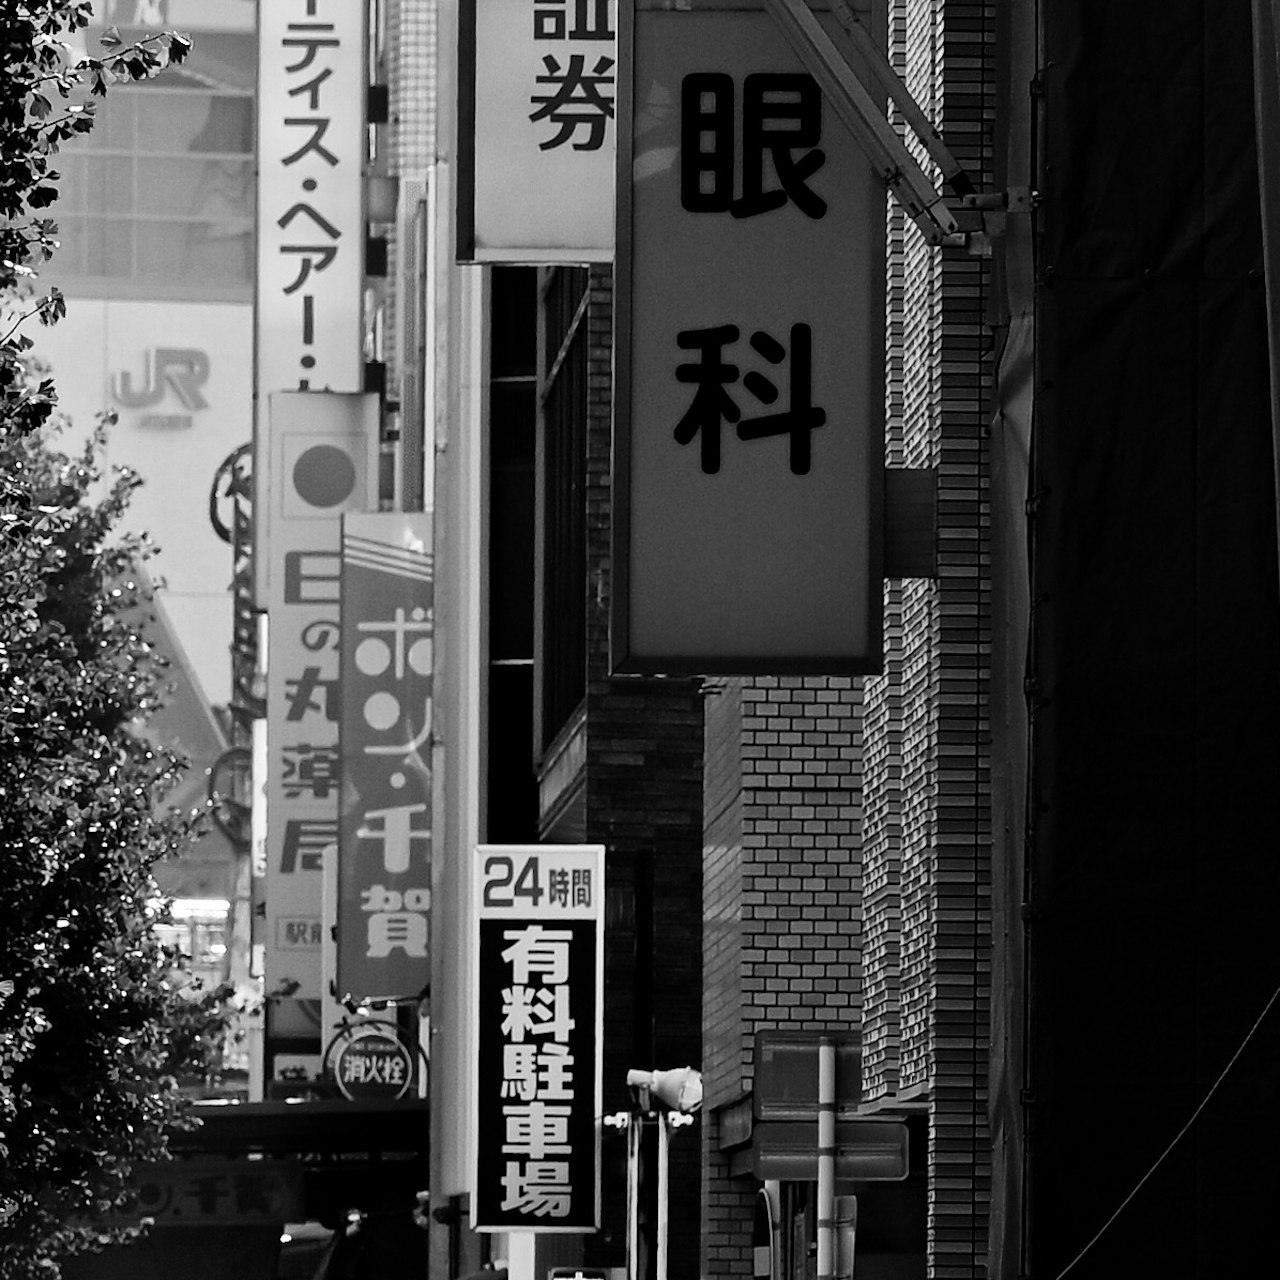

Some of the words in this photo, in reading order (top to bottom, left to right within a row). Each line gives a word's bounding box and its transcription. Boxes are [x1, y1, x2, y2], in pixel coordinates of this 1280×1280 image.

[111, 346, 210, 411] JR
[483, 856, 592, 908] 24時間
[344, 1054, 405, 1086] 消火栓
[500, 925, 575, 1217] 有料駐車場
